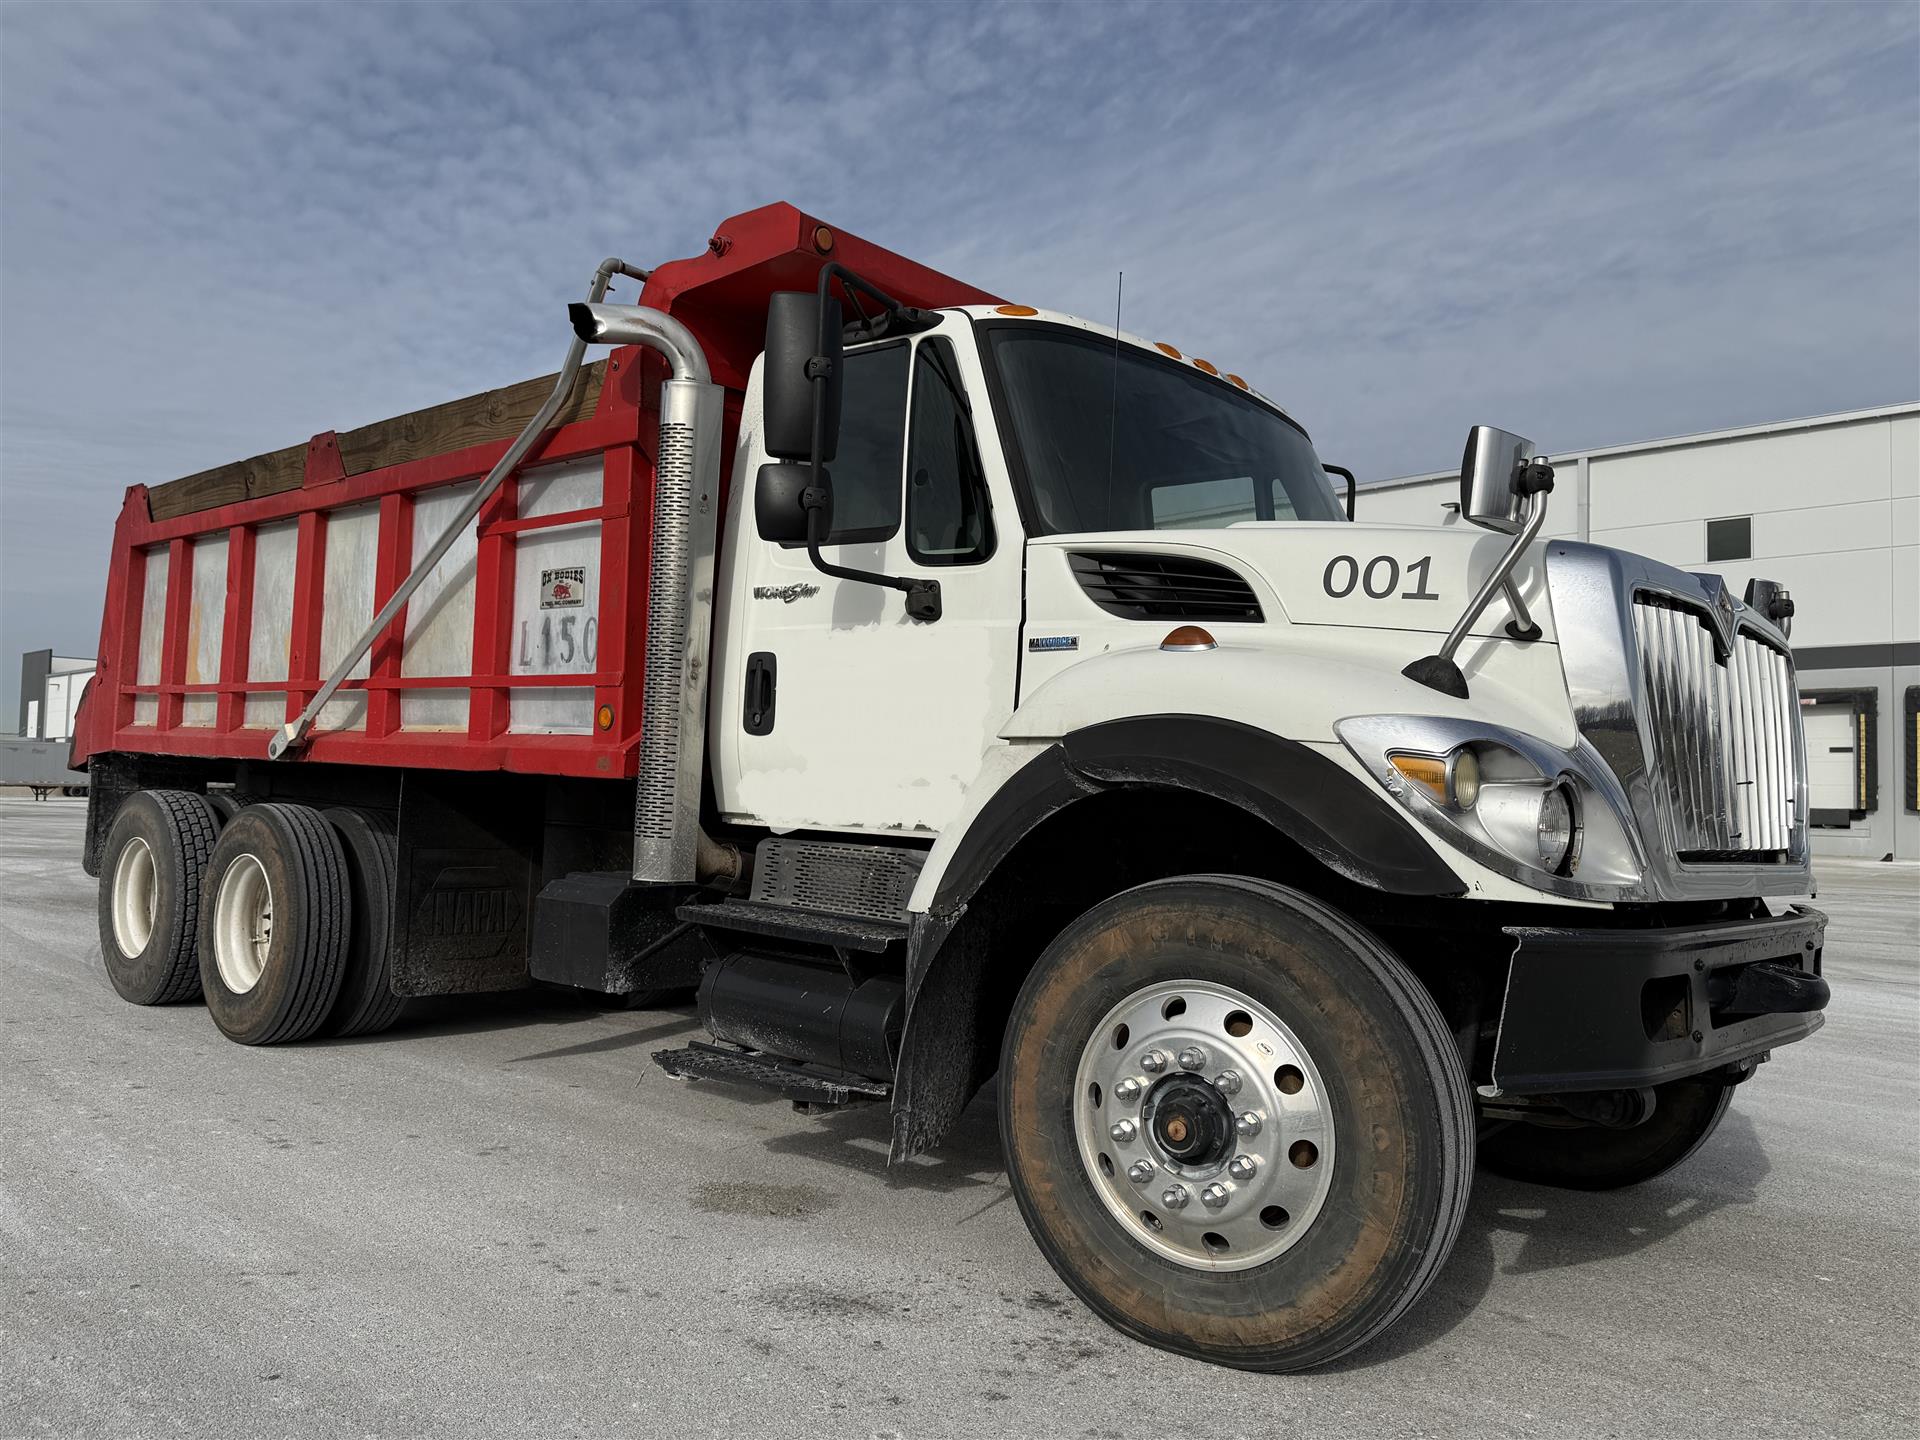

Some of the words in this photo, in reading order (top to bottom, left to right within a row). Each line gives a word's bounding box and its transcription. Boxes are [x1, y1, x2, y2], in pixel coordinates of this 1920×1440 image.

[554, 570, 584, 584] BODIES
[1323, 555, 1439, 600] 001
[435, 890, 506, 936] NAPA
